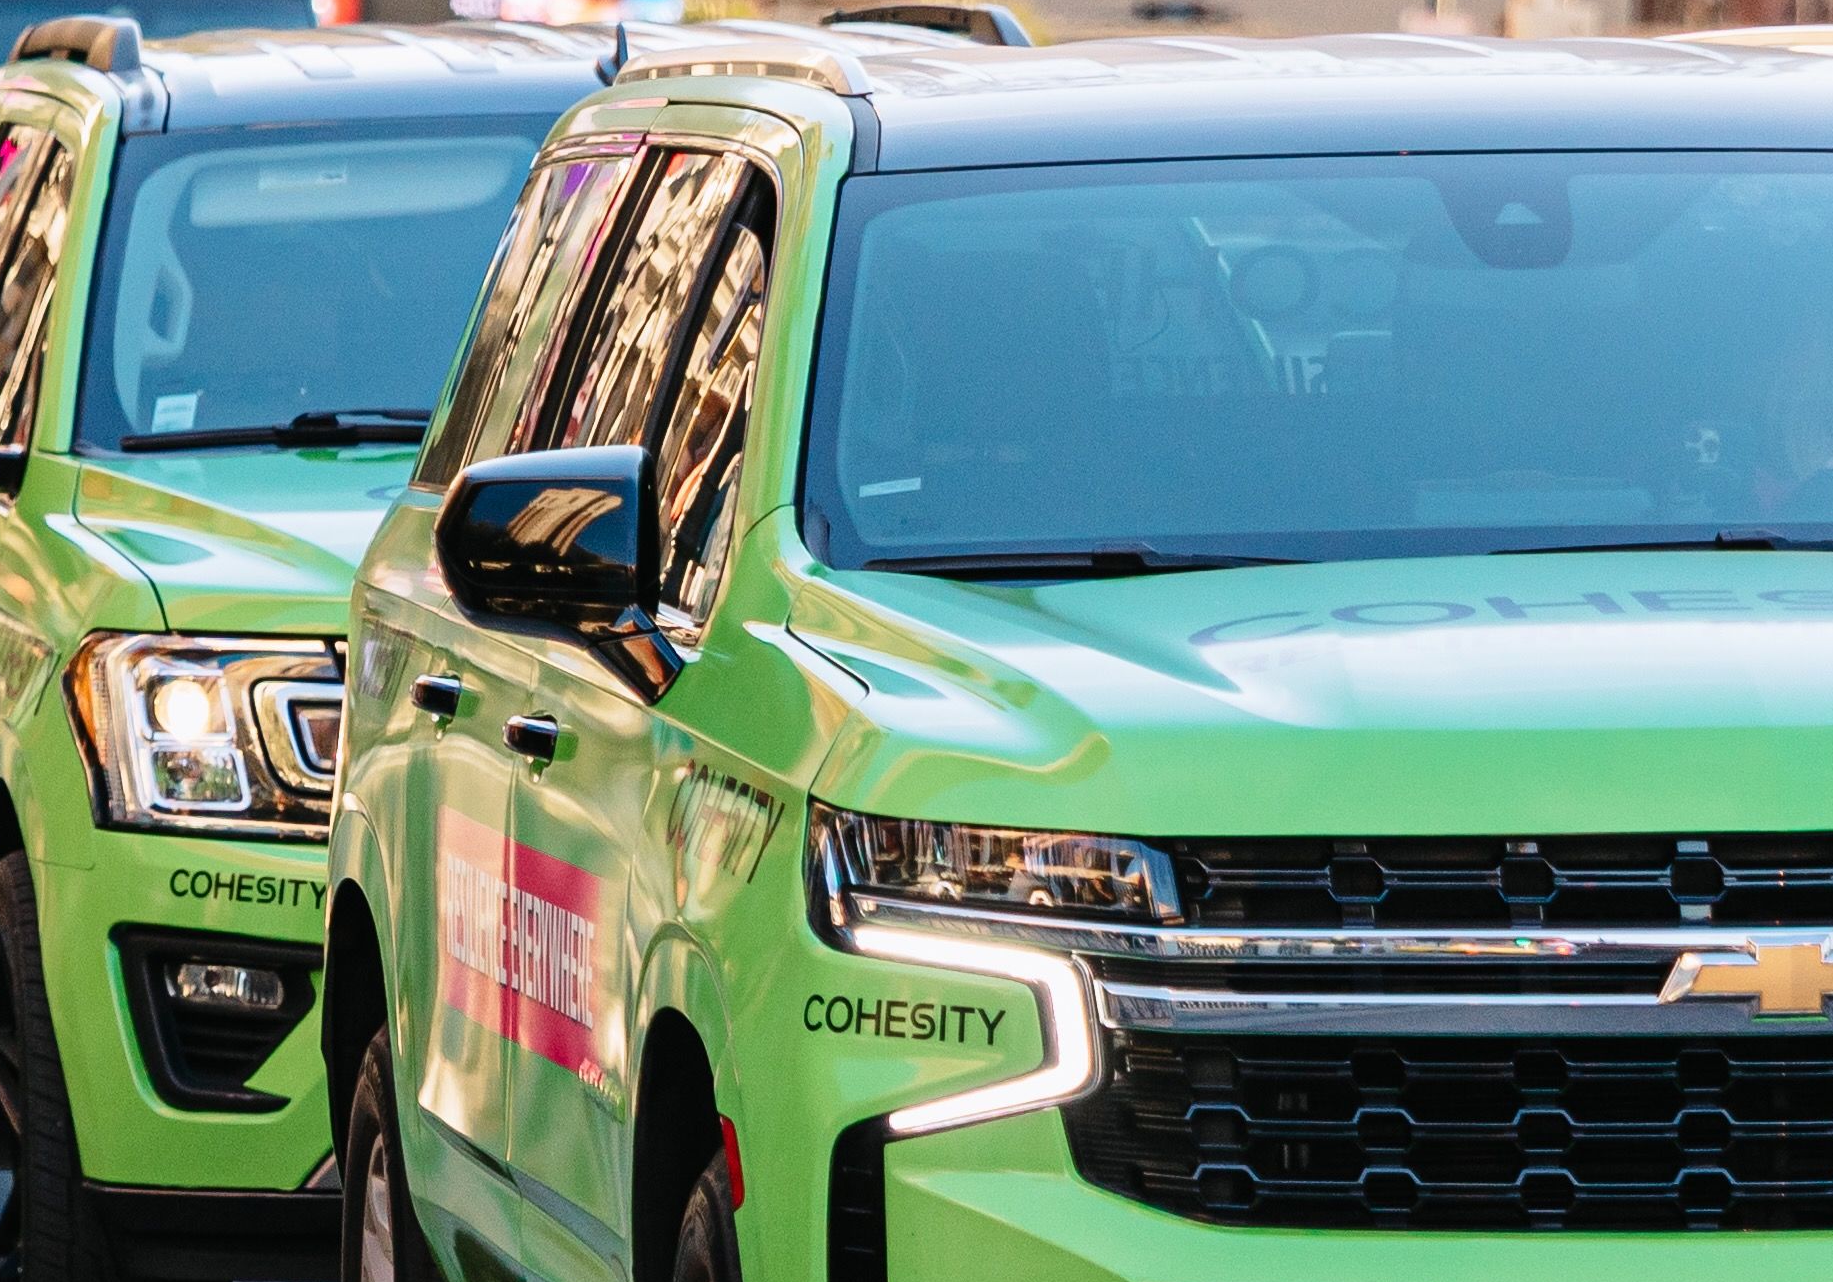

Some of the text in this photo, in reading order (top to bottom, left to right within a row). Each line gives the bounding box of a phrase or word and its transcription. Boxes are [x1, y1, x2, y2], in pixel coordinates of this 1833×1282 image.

[665, 757, 786, 885] COHESITY
[169, 868, 327, 911] COHESITY
[510, 884, 594, 1032] EVERYWHERE
[803, 993, 1007, 1047] COHESITY
